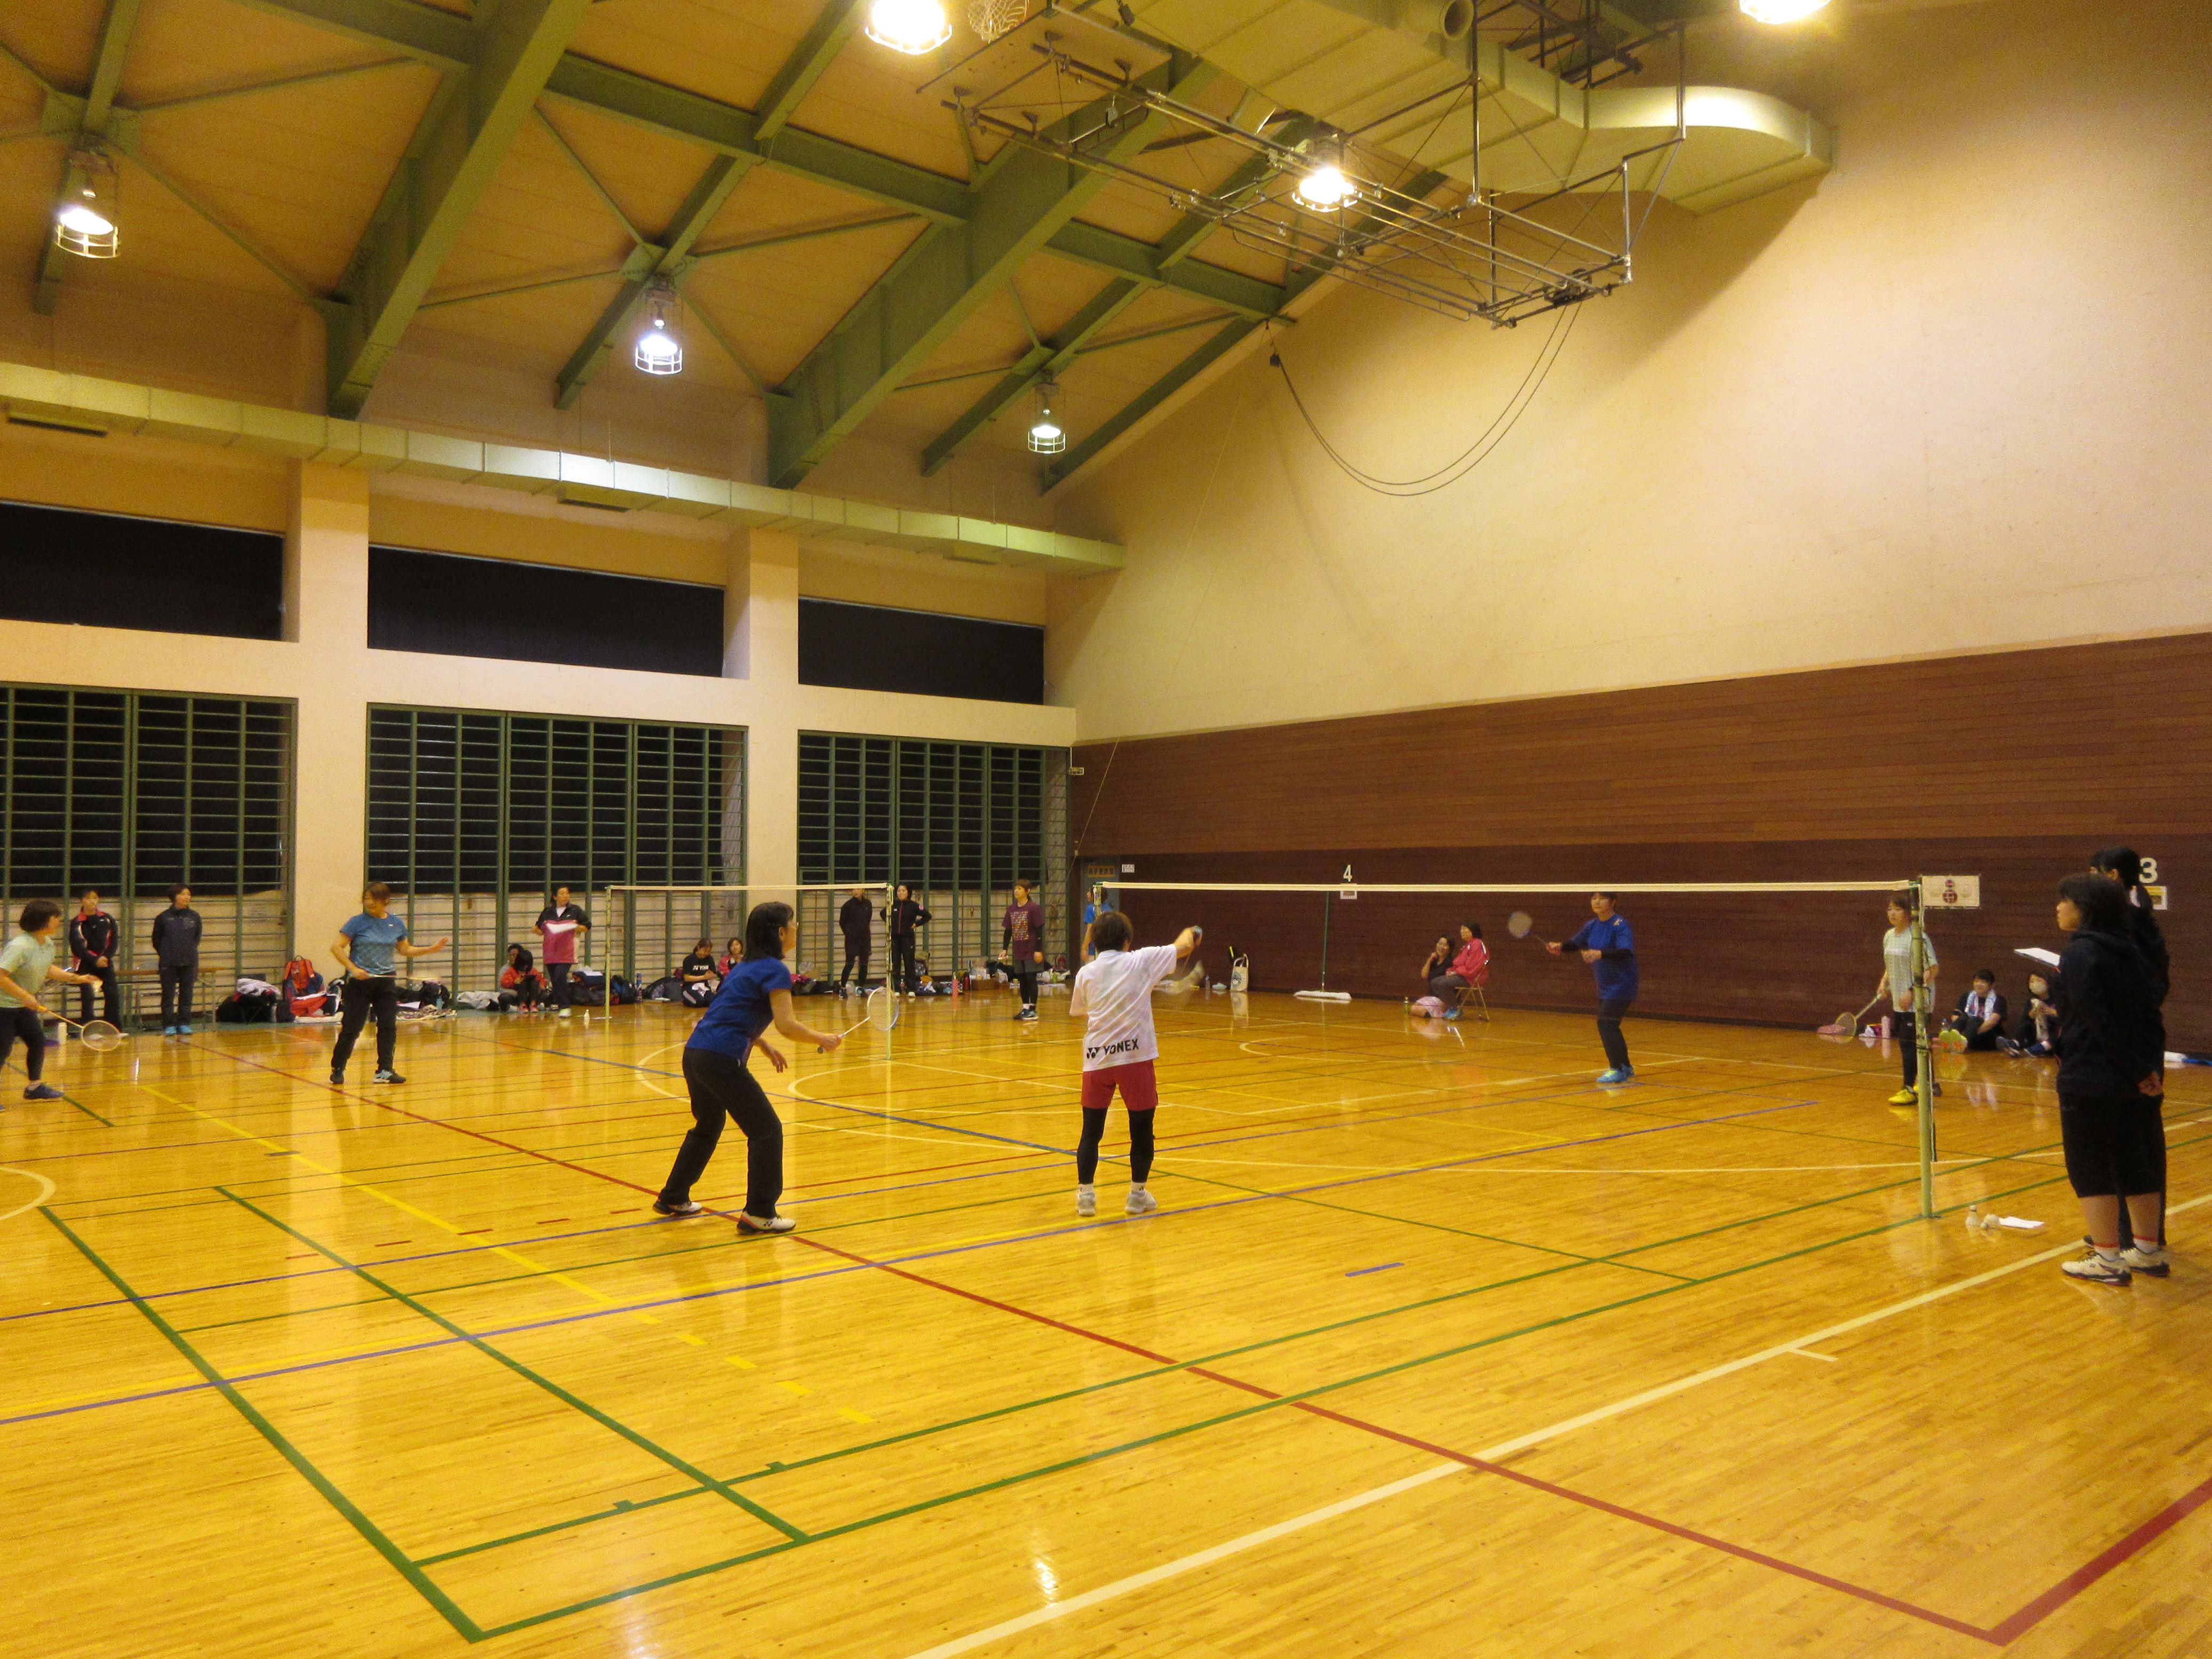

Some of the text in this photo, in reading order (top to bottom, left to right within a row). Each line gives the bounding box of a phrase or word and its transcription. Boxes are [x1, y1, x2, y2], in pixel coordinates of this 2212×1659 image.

[1343, 864, 1353, 882] 4
[2139, 857, 2158, 883] 3
[1103, 1039, 1139, 1055] YONEX
